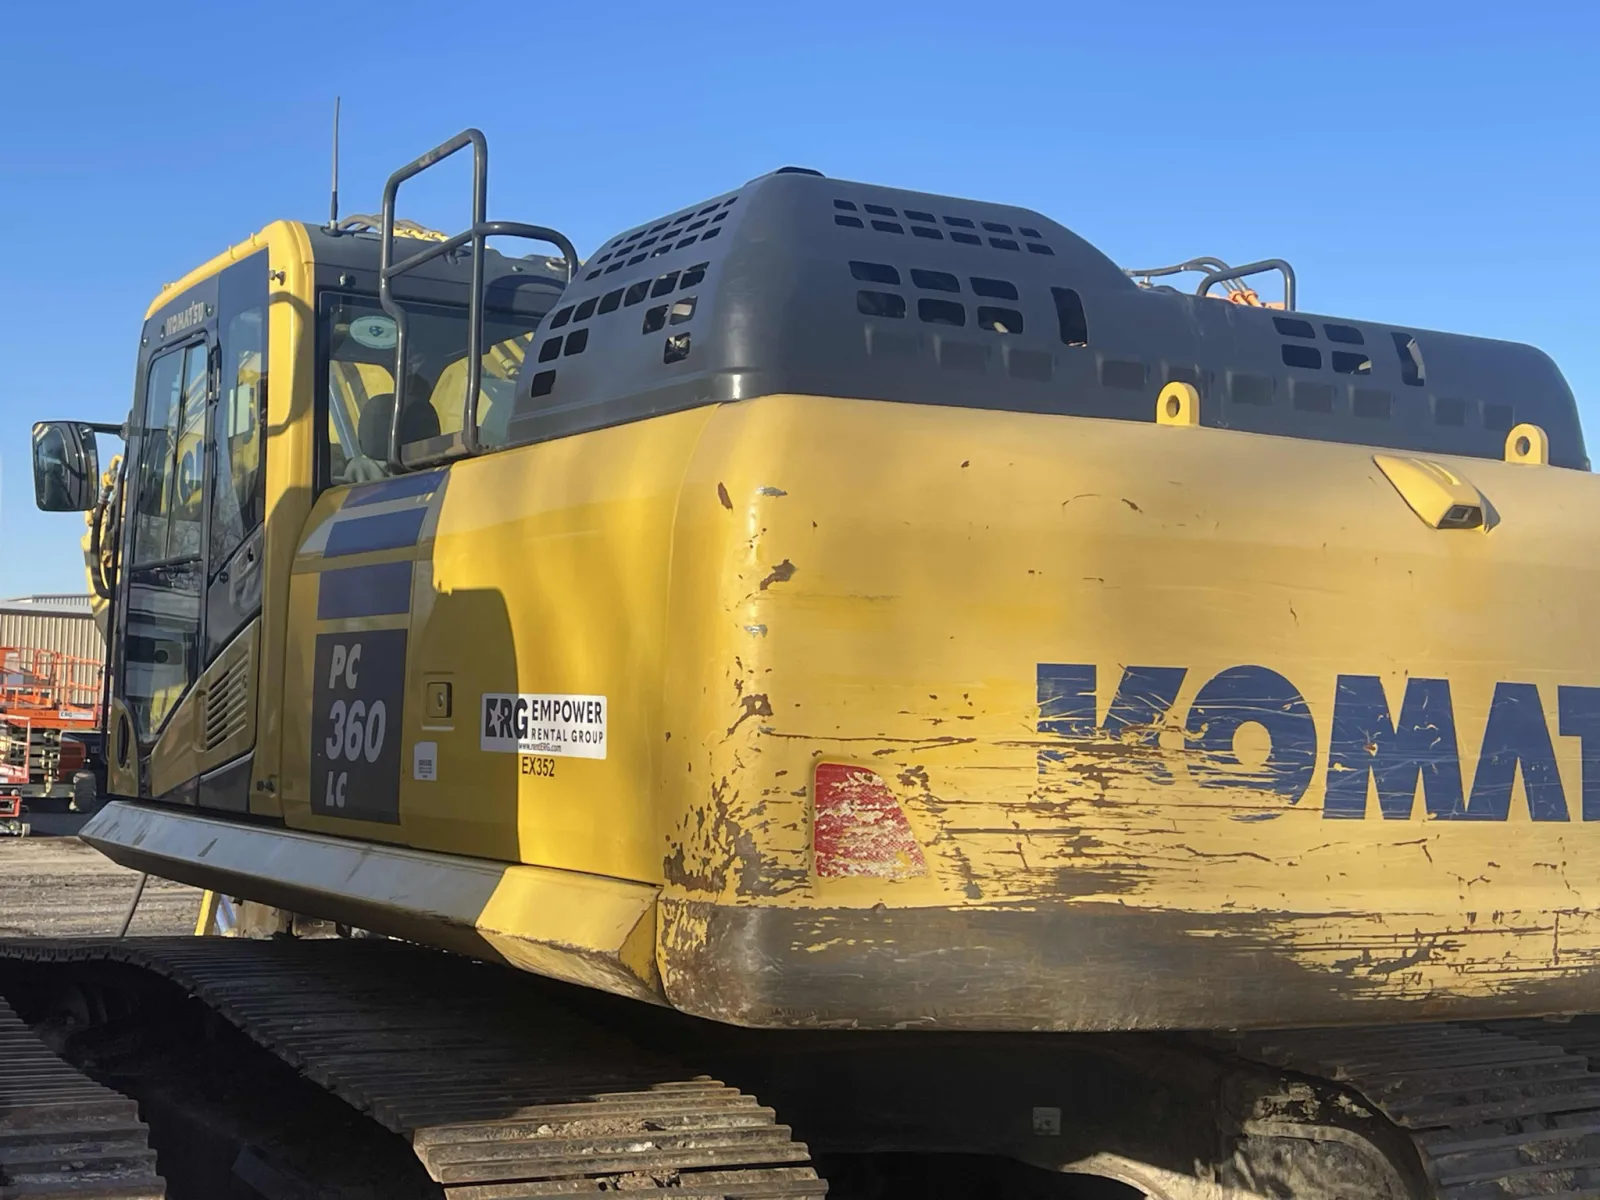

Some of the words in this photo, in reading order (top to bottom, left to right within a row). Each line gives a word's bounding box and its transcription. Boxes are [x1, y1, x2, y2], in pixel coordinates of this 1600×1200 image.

[166, 300, 204, 337] KOMATSU
[328, 643, 362, 690] PC
[485, 698, 529, 740] ERG
[531, 699, 603, 725] EMPOWER
[325, 699, 387, 764] 360
[531, 727, 568, 742] RENTAL
[571, 730, 604, 744] GROUP
[521, 756, 555, 778] EX352
[325, 770, 348, 809] LC
